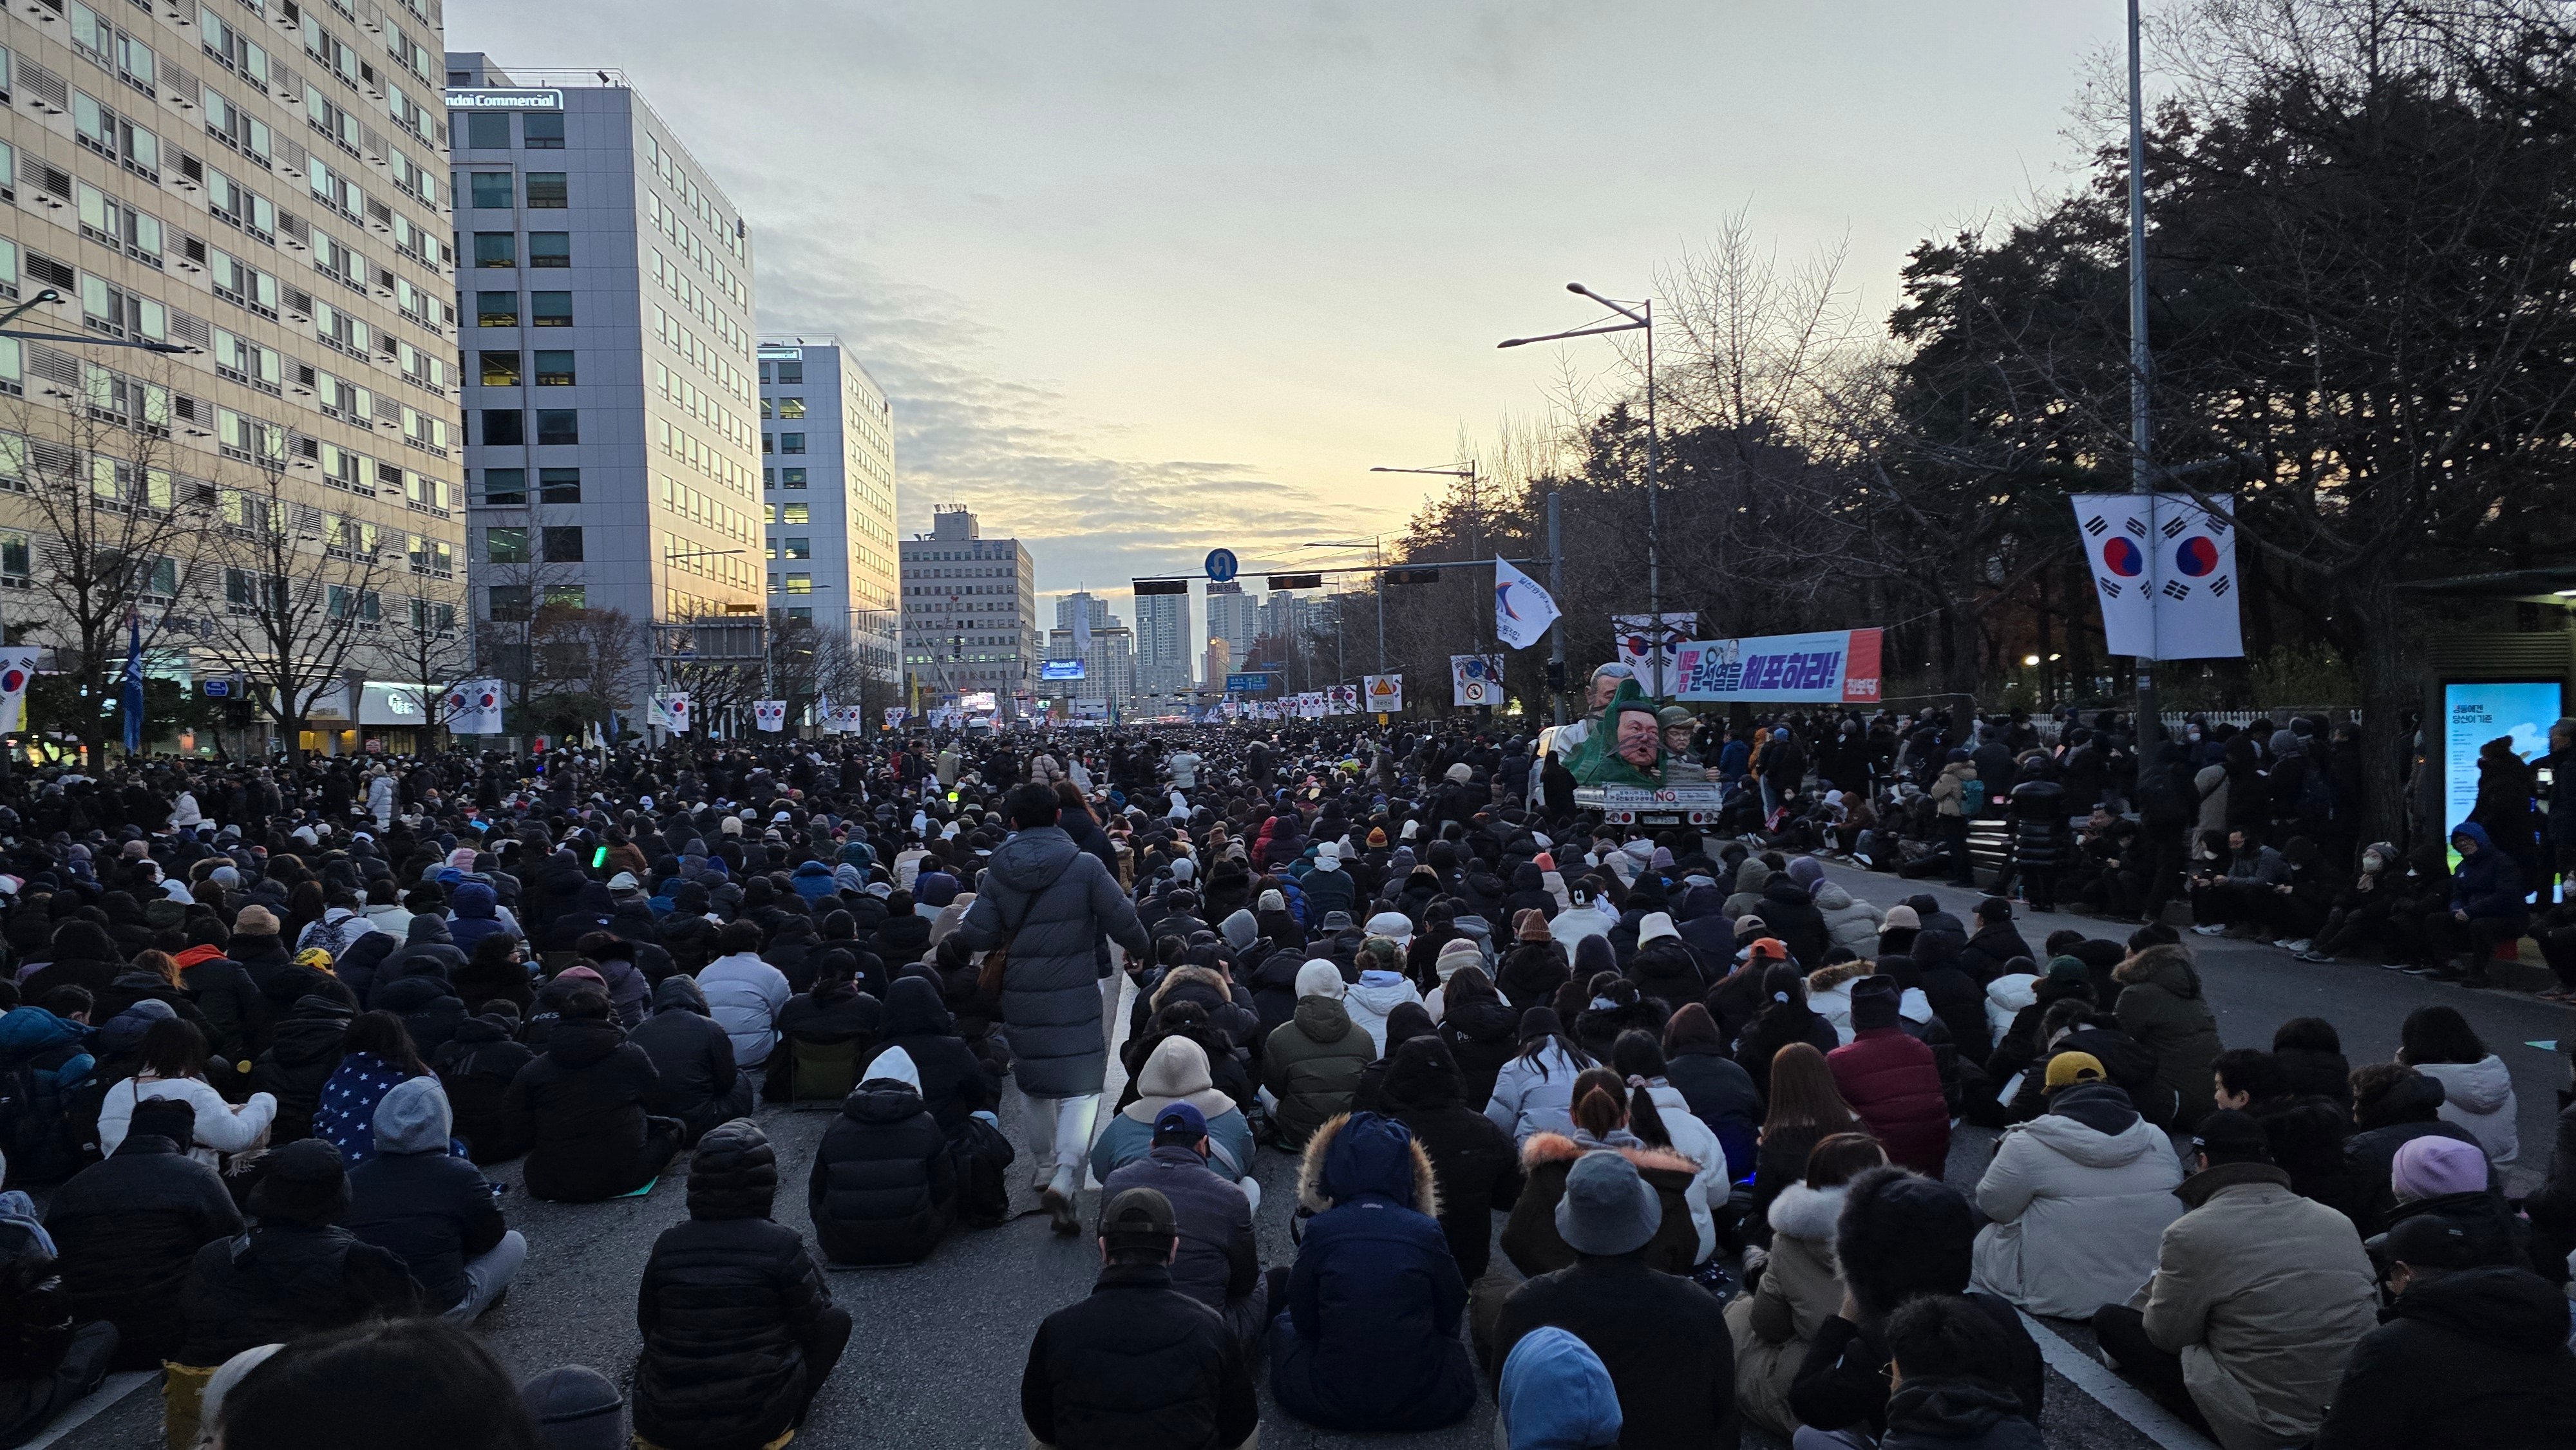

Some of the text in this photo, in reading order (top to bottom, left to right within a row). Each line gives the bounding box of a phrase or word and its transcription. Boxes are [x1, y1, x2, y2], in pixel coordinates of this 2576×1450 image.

[445, 94, 554, 106] ndai Commercial
[1690, 663, 1743, 692] 윤석열을
[1739, 651, 1842, 690] 체포하라!
[1846, 678, 1879, 696] 진보당
[2452, 715, 2492, 724] 당신이 기준
[1655, 791, 1676, 802] NO
